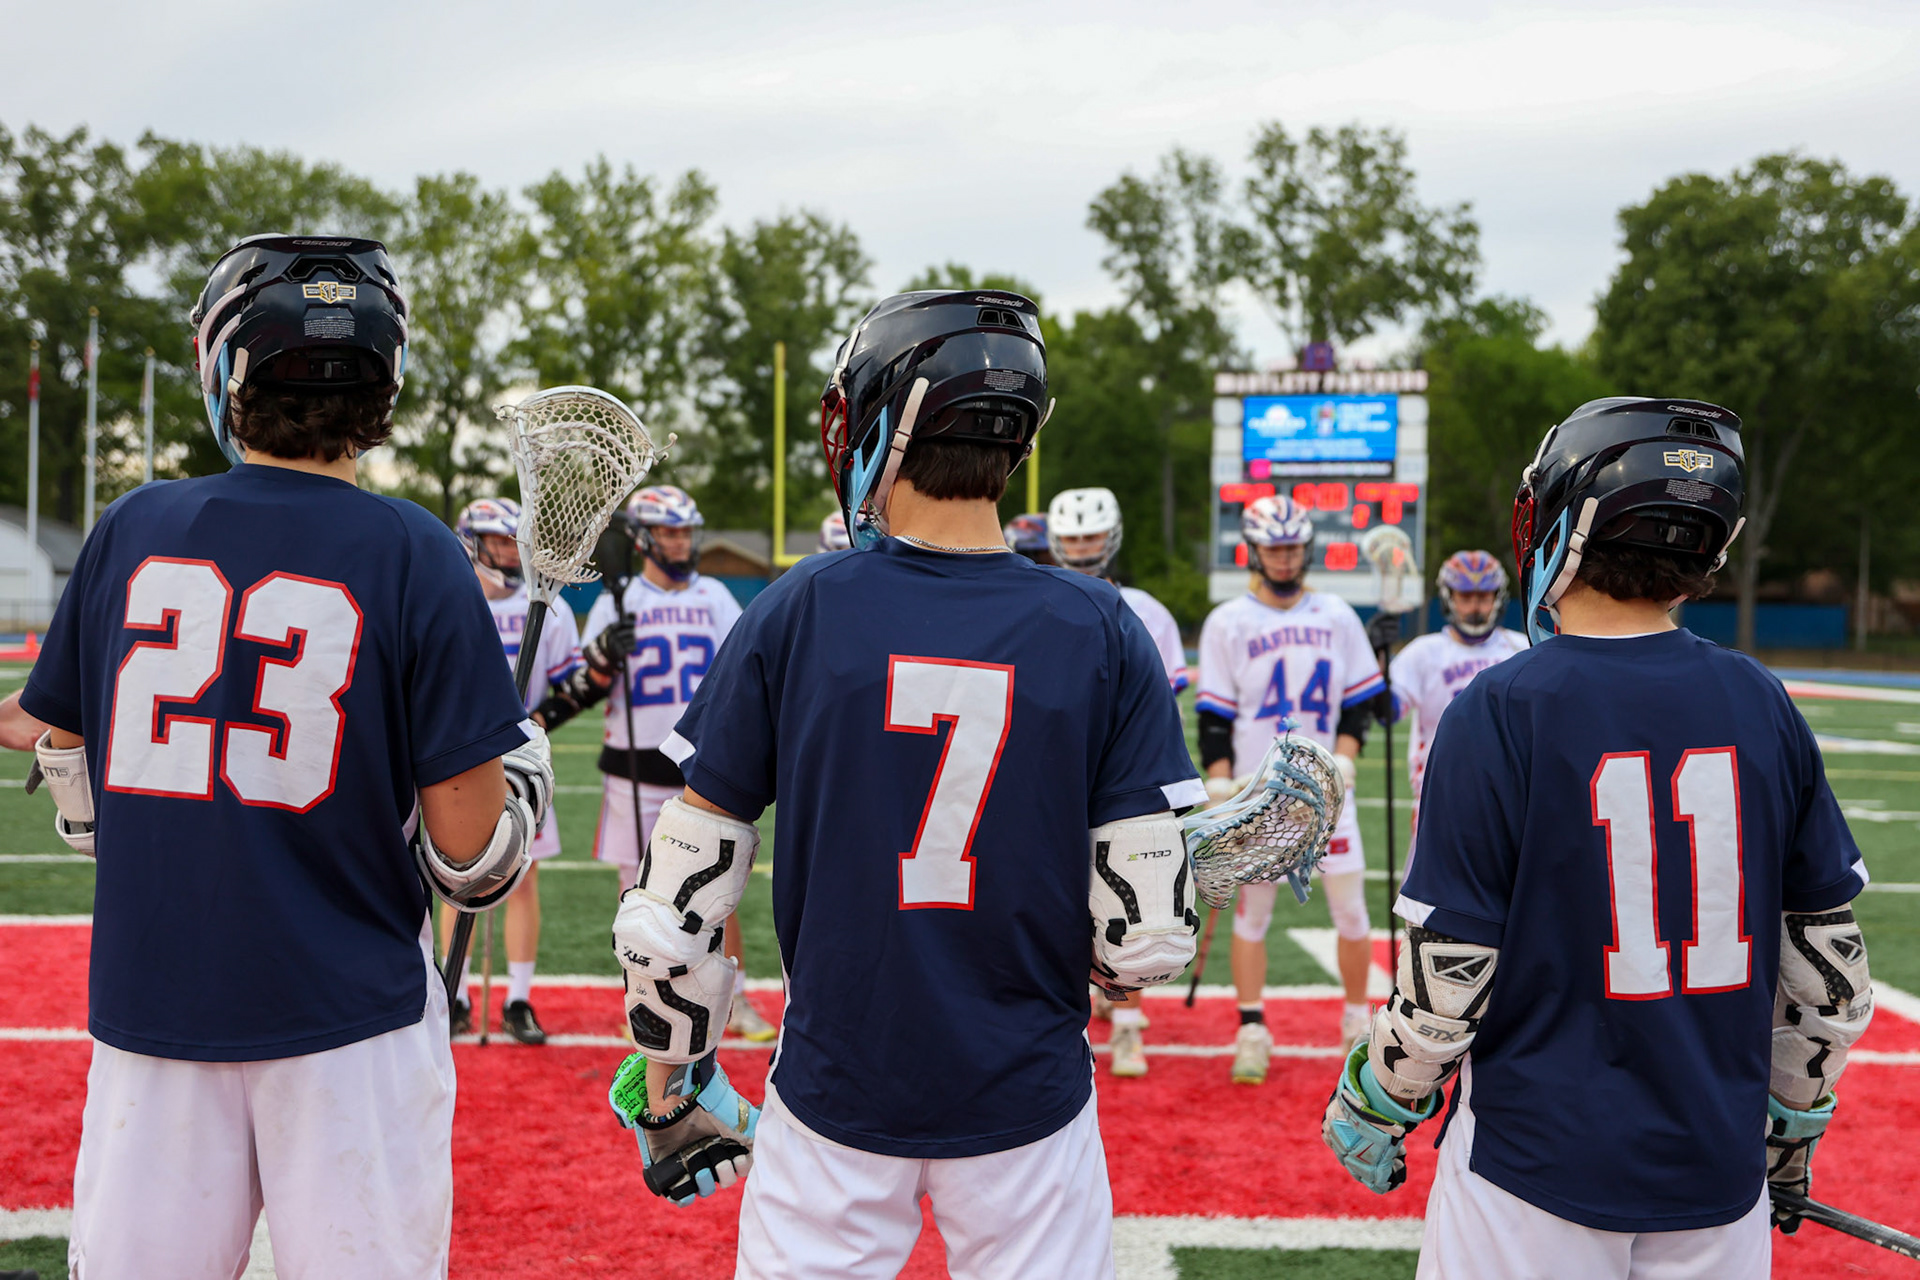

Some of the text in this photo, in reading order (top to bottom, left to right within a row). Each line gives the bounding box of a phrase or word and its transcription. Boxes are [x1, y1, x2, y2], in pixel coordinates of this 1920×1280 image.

[975, 295, 1025, 308] cascade
[1666, 404, 1722, 419] cascade
[634, 606, 716, 628] ARTLETT
[1248, 625, 1333, 659] BARTLETT
[104, 555, 364, 815] 23
[631, 632, 718, 708] 22
[1254, 657, 1332, 733] 44
[884, 653, 1016, 911] 7
[1589, 745, 1753, 1001] 11
[1417, 1023, 1459, 1042] STX
